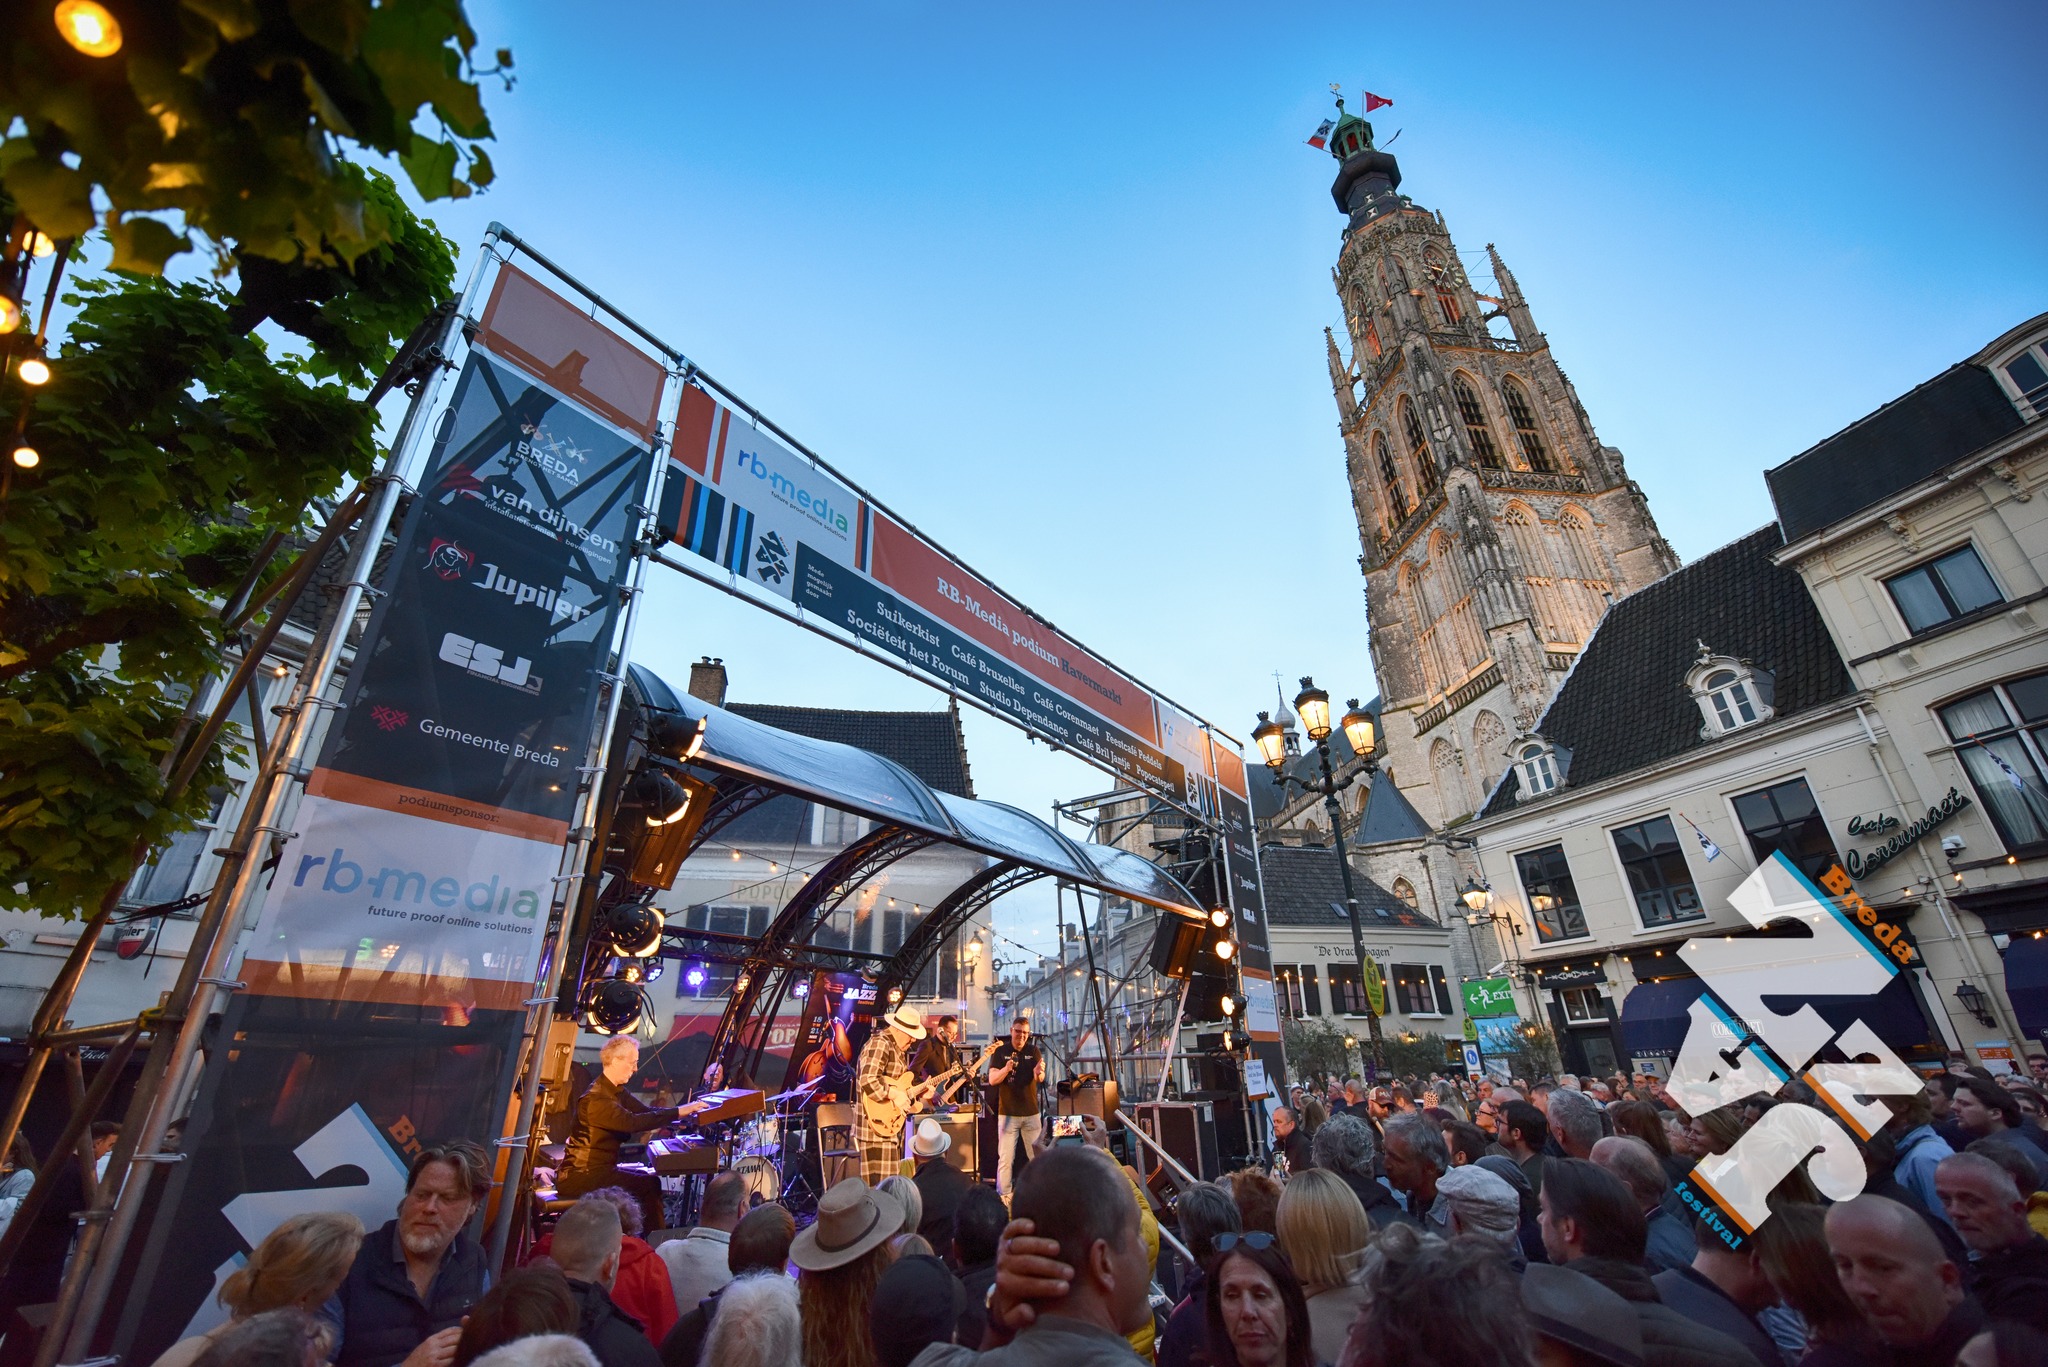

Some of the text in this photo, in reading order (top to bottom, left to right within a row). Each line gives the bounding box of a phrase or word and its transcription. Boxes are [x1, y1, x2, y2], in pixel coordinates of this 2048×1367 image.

[515, 452, 580, 488] BRENGT HET SAMEN
[516, 440, 579, 482] BREDA
[491, 484, 616, 553] van dijnsen
[770, 491, 848, 541] future proof online solutions
[806, 581, 832, 598] gemaakt
[807, 564, 825, 578] Mede
[807, 572, 834, 591] mogelijk
[471, 562, 591, 623] Jupiler
[805, 588, 820, 600] door
[438, 631, 533, 686] ESJ
[936, 576, 1123, 706] RB-Media podium Havermarkt
[466, 669, 540, 697] FINANCIAL ENGINEERING
[846, 608, 907, 652] Sociëteit
[908, 641, 930, 665] het
[930, 653, 970, 686] Forum
[979, 680, 1012, 707] Studio
[1012, 698, 1069, 738] Dependance
[1075, 732, 1095, 751] Café
[1095, 742, 1110, 759] Bril
[876, 600, 940, 648] Suikerkist
[951, 644, 977, 668] Café
[978, 658, 1026, 695] Bruxelles
[1033, 691, 1054, 711] Café
[1055, 704, 1100, 736] Corenmaet
[1105, 730, 1138, 757] Feestcafé
[1137, 748, 1163, 770] Peddels
[419, 718, 560, 768] Gemeente Breda
[398, 793, 501, 823] podiumsponsor:
[1846, 786, 1966, 881] Corenmaet
[367, 904, 534, 936] future proof online solutions
[843, 987, 878, 1000] JAZZ
